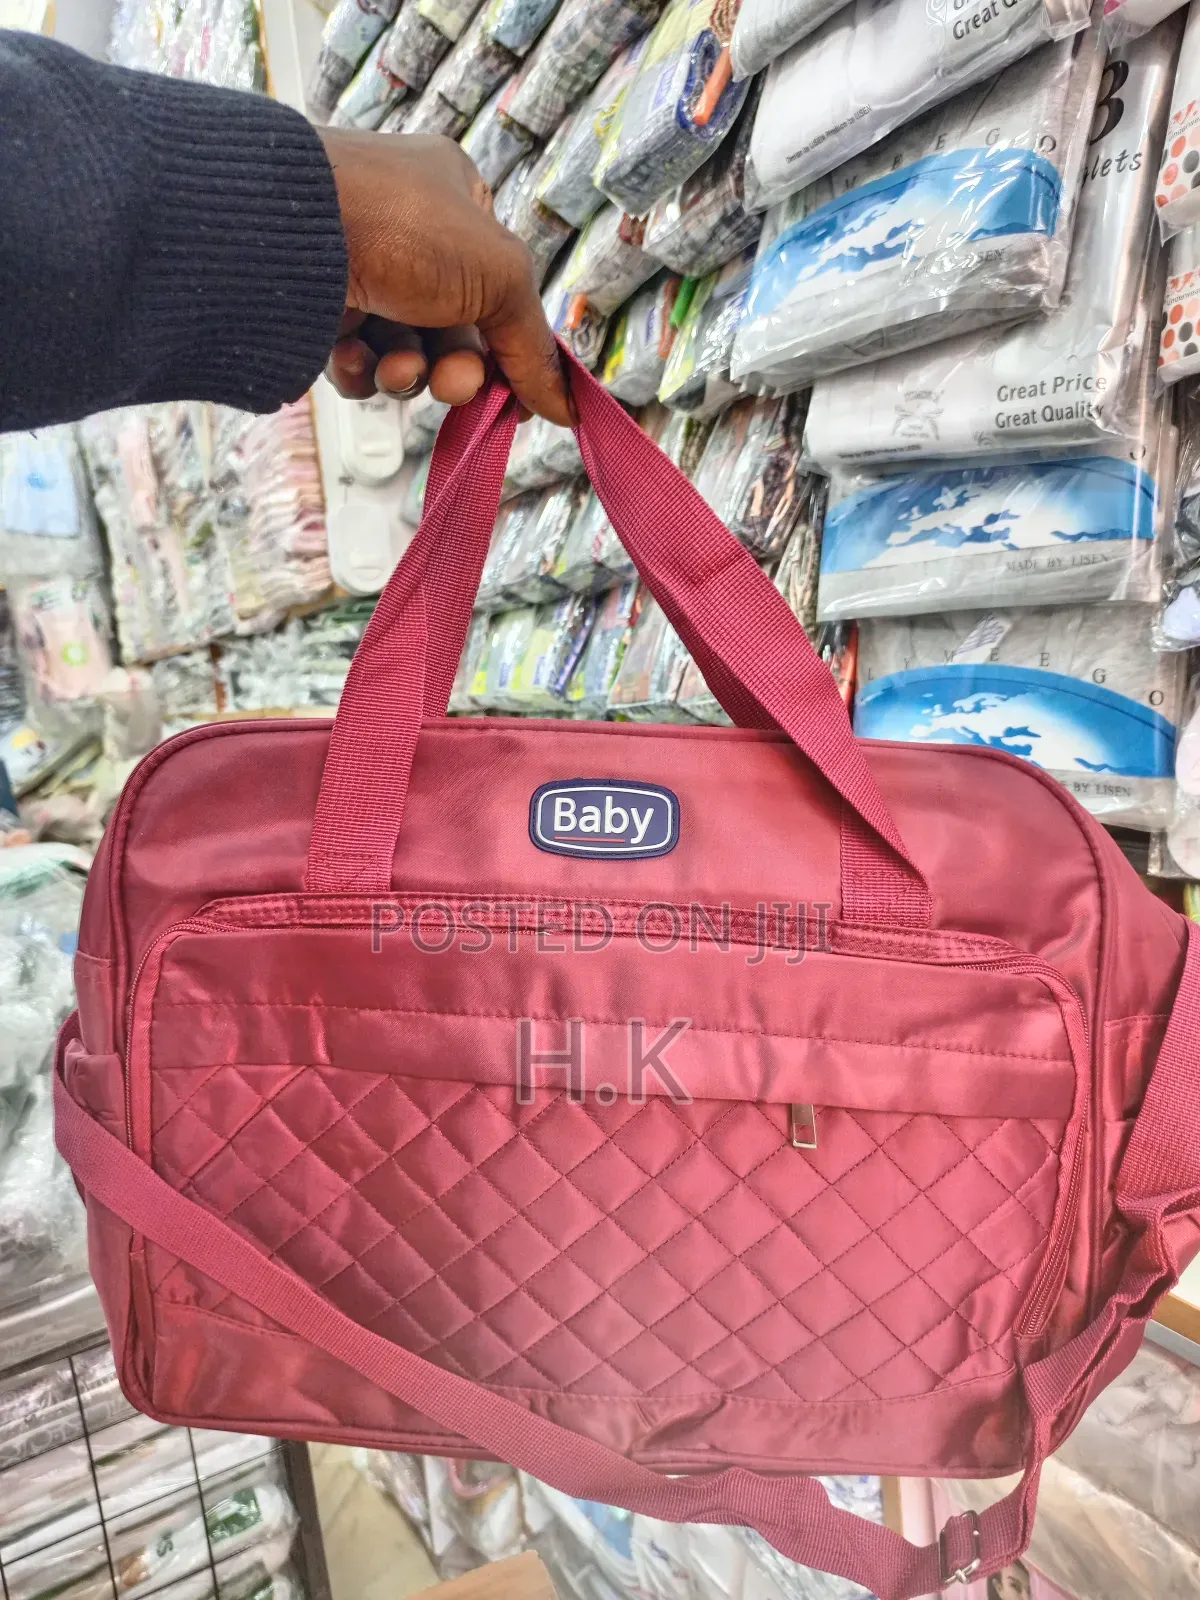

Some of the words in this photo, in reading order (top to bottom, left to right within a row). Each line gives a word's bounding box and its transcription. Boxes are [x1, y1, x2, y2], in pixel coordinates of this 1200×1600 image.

[952, 0, 1000, 40] Great
[996, 380, 1047, 402] Great
[1051, 373, 1107, 394] Price
[994, 408, 1038, 429] Great
[1040, 400, 1104, 423] Quality
[1047, 557, 1064, 568] BY
[1073, 781, 1090, 793] BY
[1095, 783, 1133, 797] LISEN
[553, 795, 655, 844] Baby
